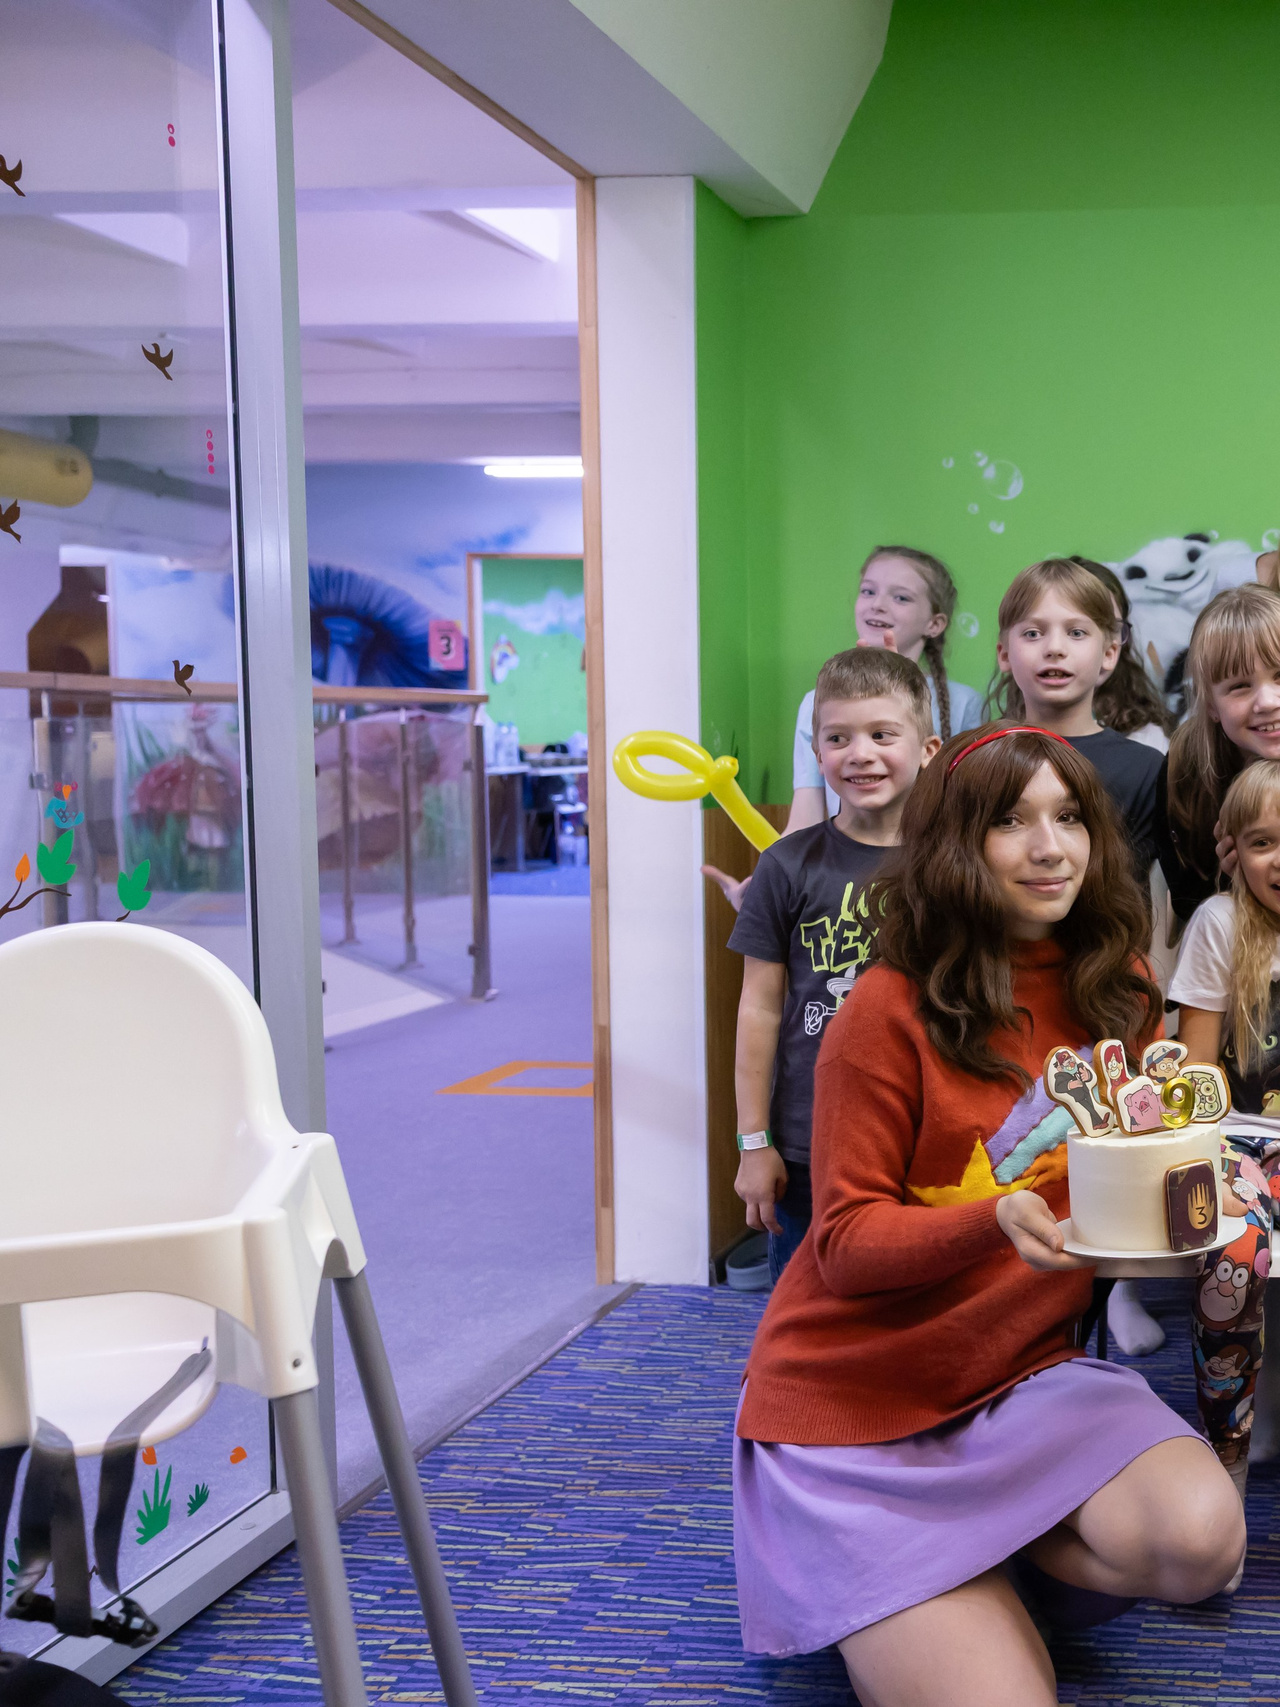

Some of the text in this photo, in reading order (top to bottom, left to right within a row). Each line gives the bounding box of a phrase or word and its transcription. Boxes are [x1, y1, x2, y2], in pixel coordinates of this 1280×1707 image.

[440, 635, 452, 656] 3
[1160, 1077, 1196, 1129] 9
[1195, 1206, 1208, 1225] 3
